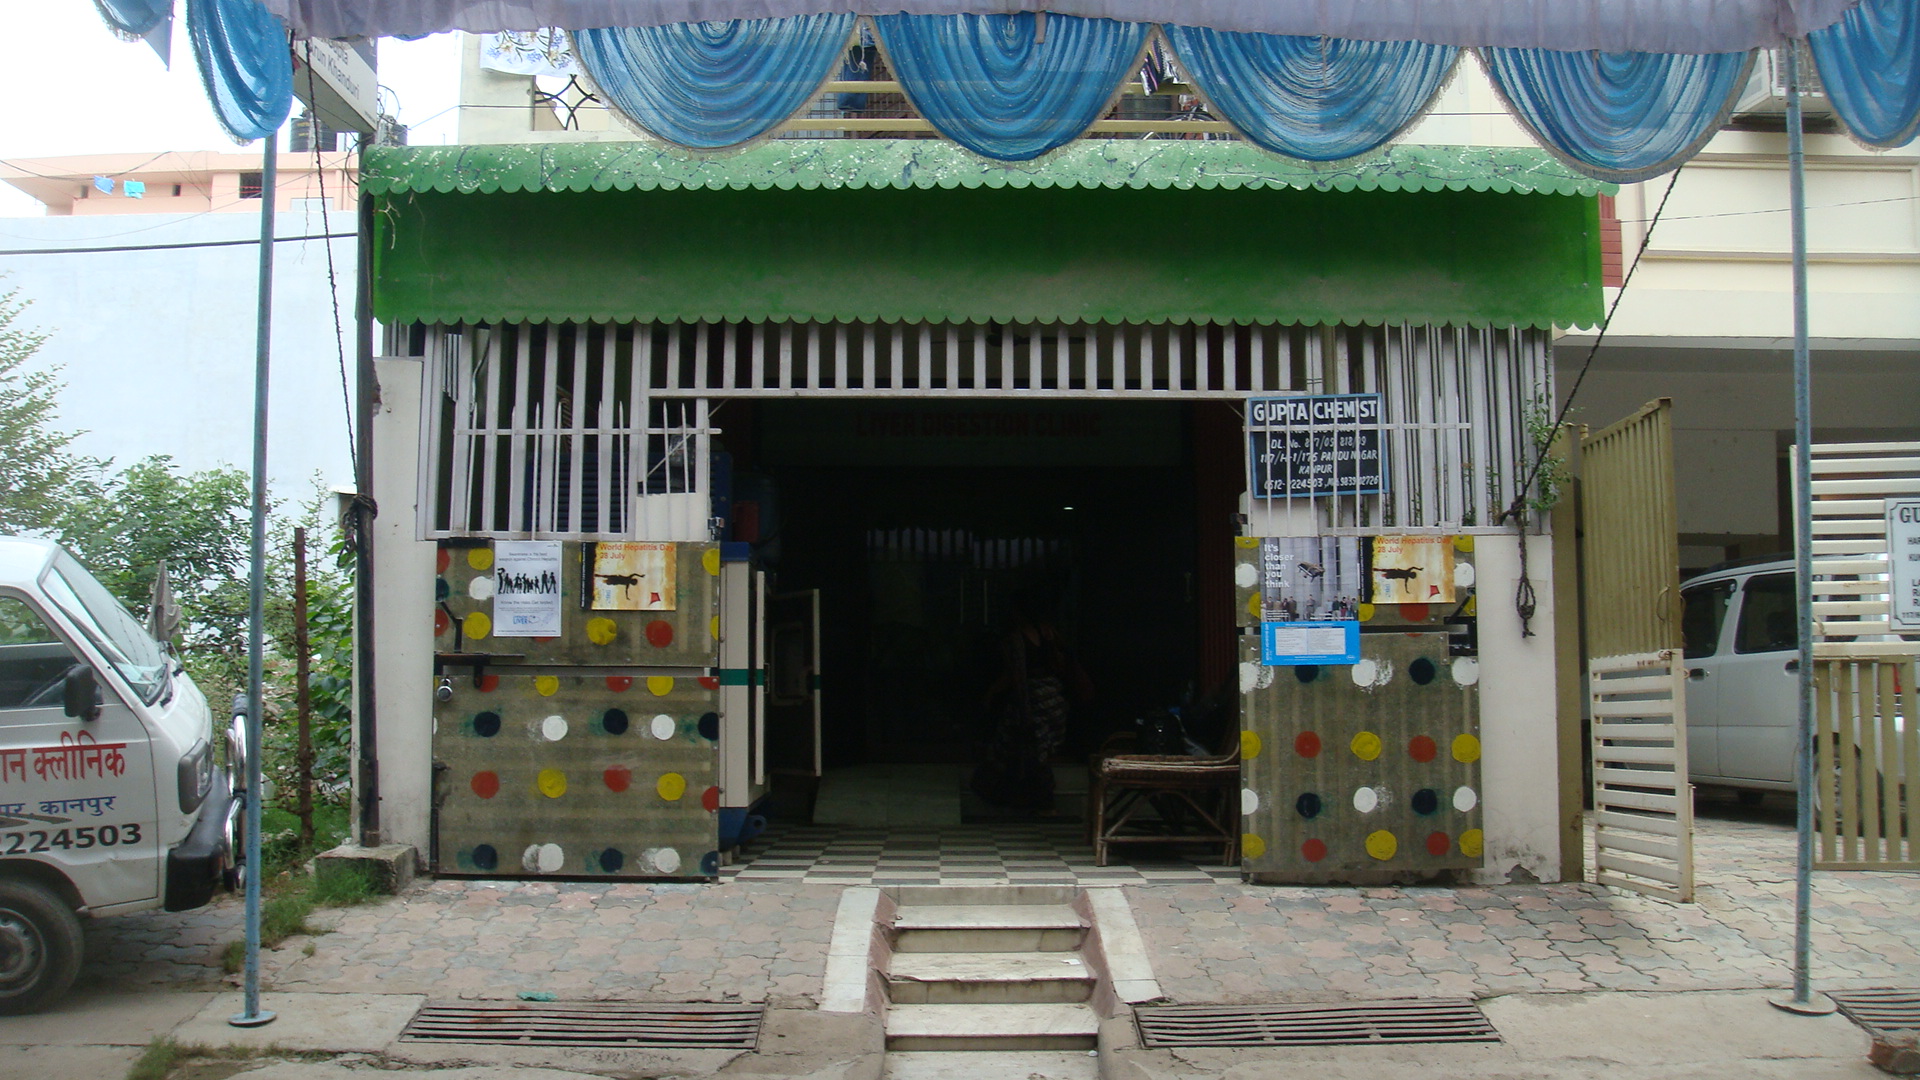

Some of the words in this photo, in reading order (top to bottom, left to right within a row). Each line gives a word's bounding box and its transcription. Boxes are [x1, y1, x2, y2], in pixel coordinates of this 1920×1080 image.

[1253, 402, 1308, 422] GUPTA
[1313, 400, 1377, 420] CHEMST
[1304, 436, 1335, 450] 87/09
[1401, 537, 1435, 545] Hepatitis
[1437, 537, 1451, 545] Day
[624, 544, 657, 552] Hepatitis
[659, 544, 674, 552] Day
[1264, 544, 1279, 552] It's
[1388, 546, 1403, 554] July
[610, 552, 625, 560] July
[1264, 553, 1294, 561] closer
[1265, 562, 1286, 570] than
[1265, 572, 1282, 580] you
[1265, 580, 1290, 588] think
[32, 730, 127, 782] क्लीनिक
[38, 796, 117, 817] कानपुर
[0, 823, 142, 856] 224503
